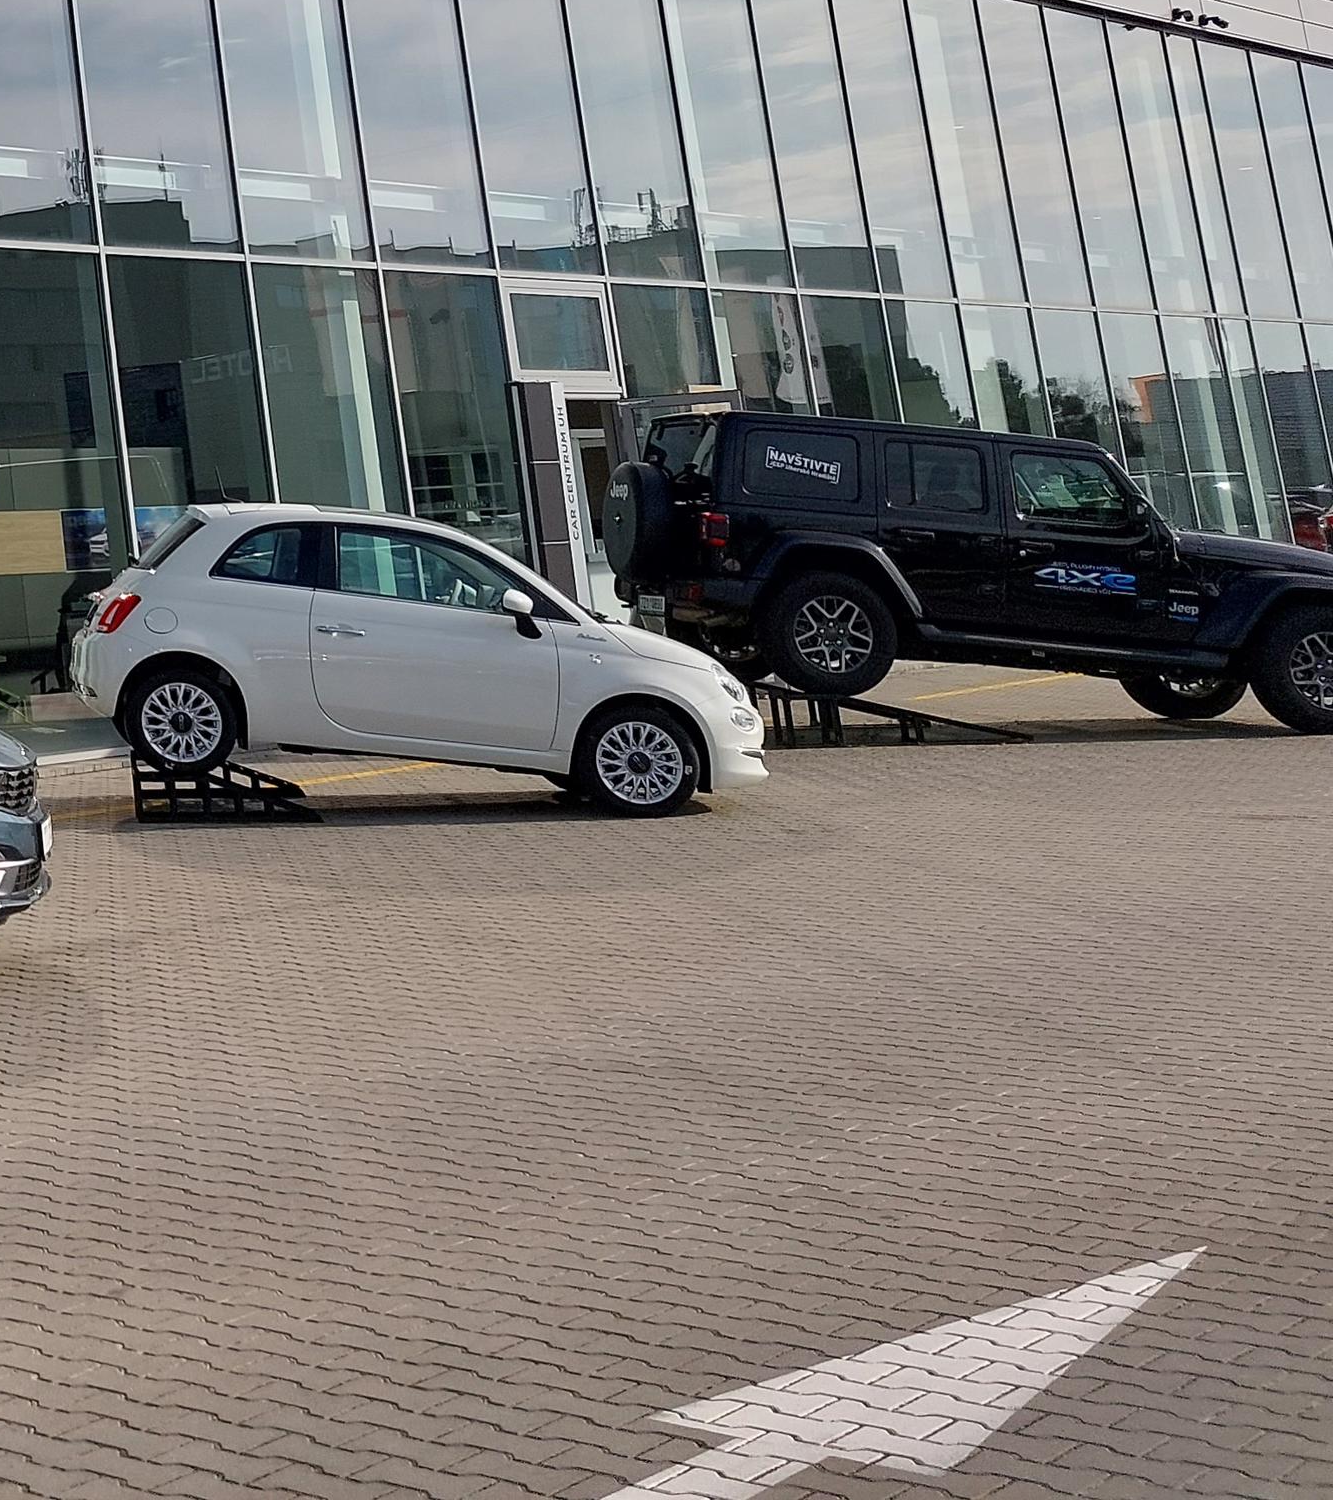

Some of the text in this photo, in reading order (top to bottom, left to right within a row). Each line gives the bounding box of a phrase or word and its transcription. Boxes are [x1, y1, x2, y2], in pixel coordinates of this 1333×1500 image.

[557, 406, 580, 541] CAR CENTRUM UH
[769, 449, 838, 475] NAVŠTIVTE
[610, 480, 629, 501] Jeep
[1169, 602, 1200, 615] Jeep
